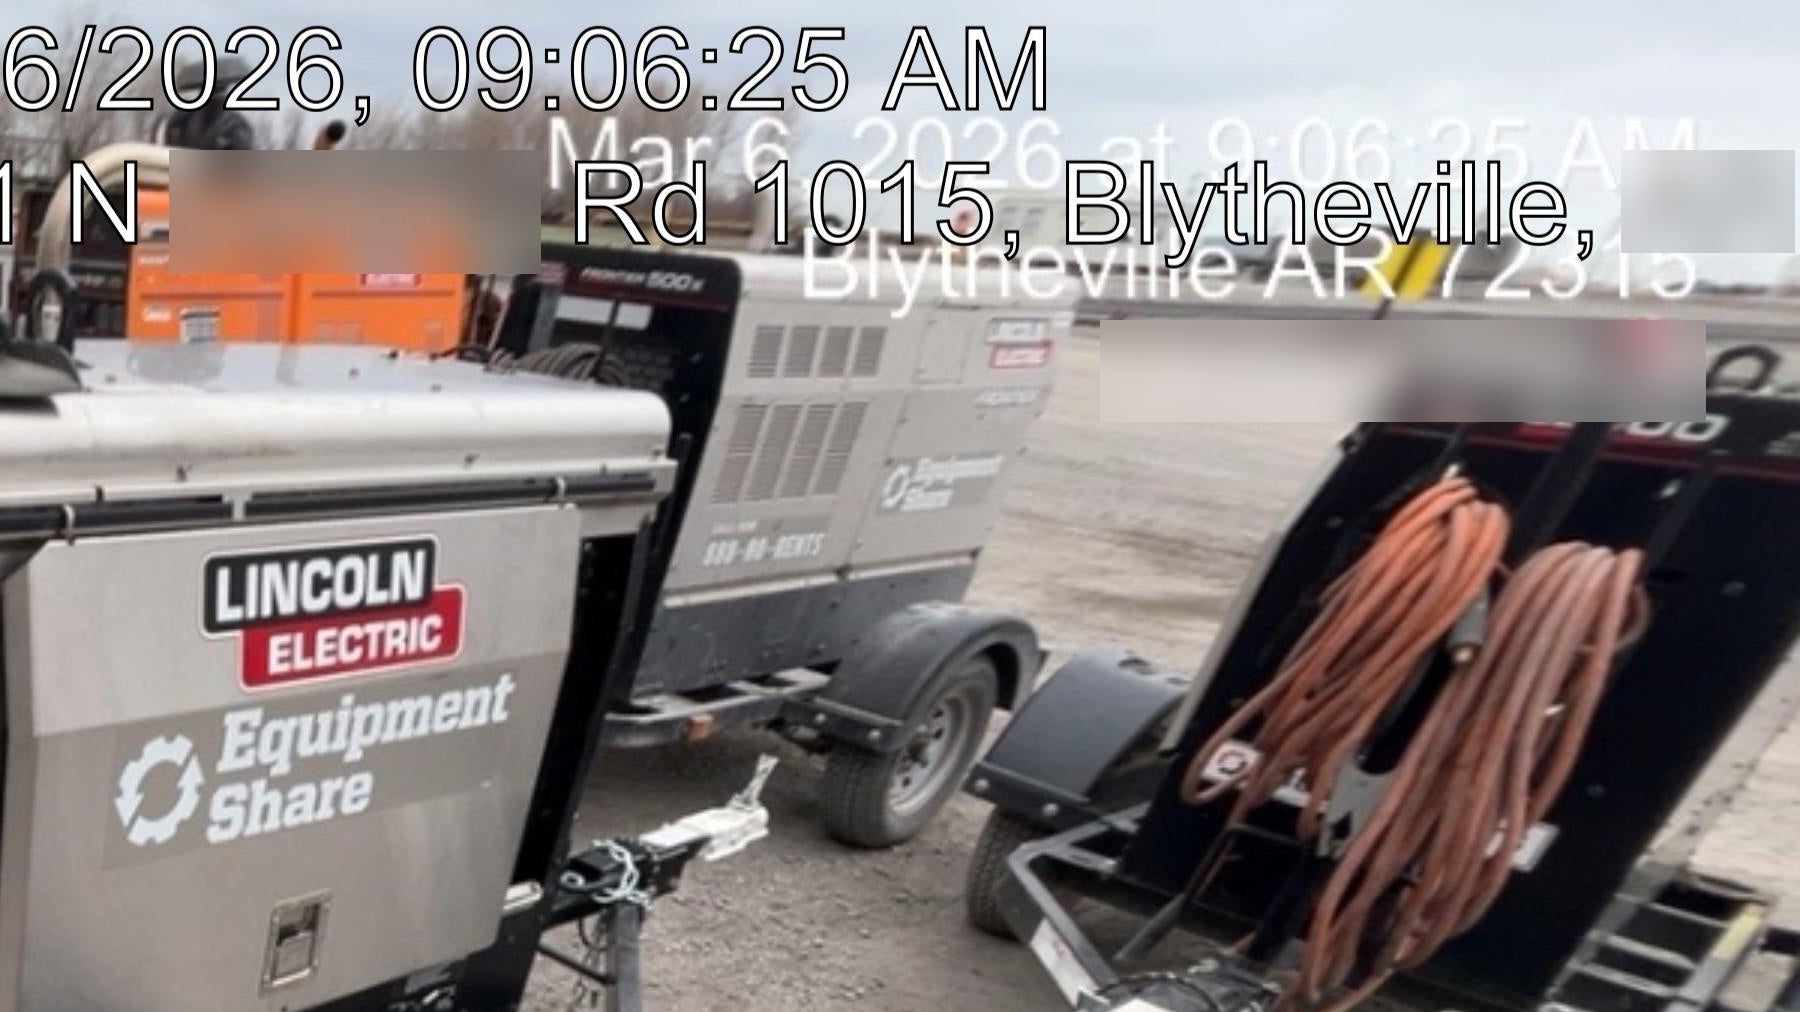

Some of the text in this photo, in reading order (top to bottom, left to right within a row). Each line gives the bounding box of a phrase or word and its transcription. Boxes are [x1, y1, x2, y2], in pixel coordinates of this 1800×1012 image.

[215, 549, 426, 623] LINCOLN
[267, 612, 444, 675] ELECTRIC
[216, 672, 516, 777] Equipment
[206, 771, 374, 844] Share
